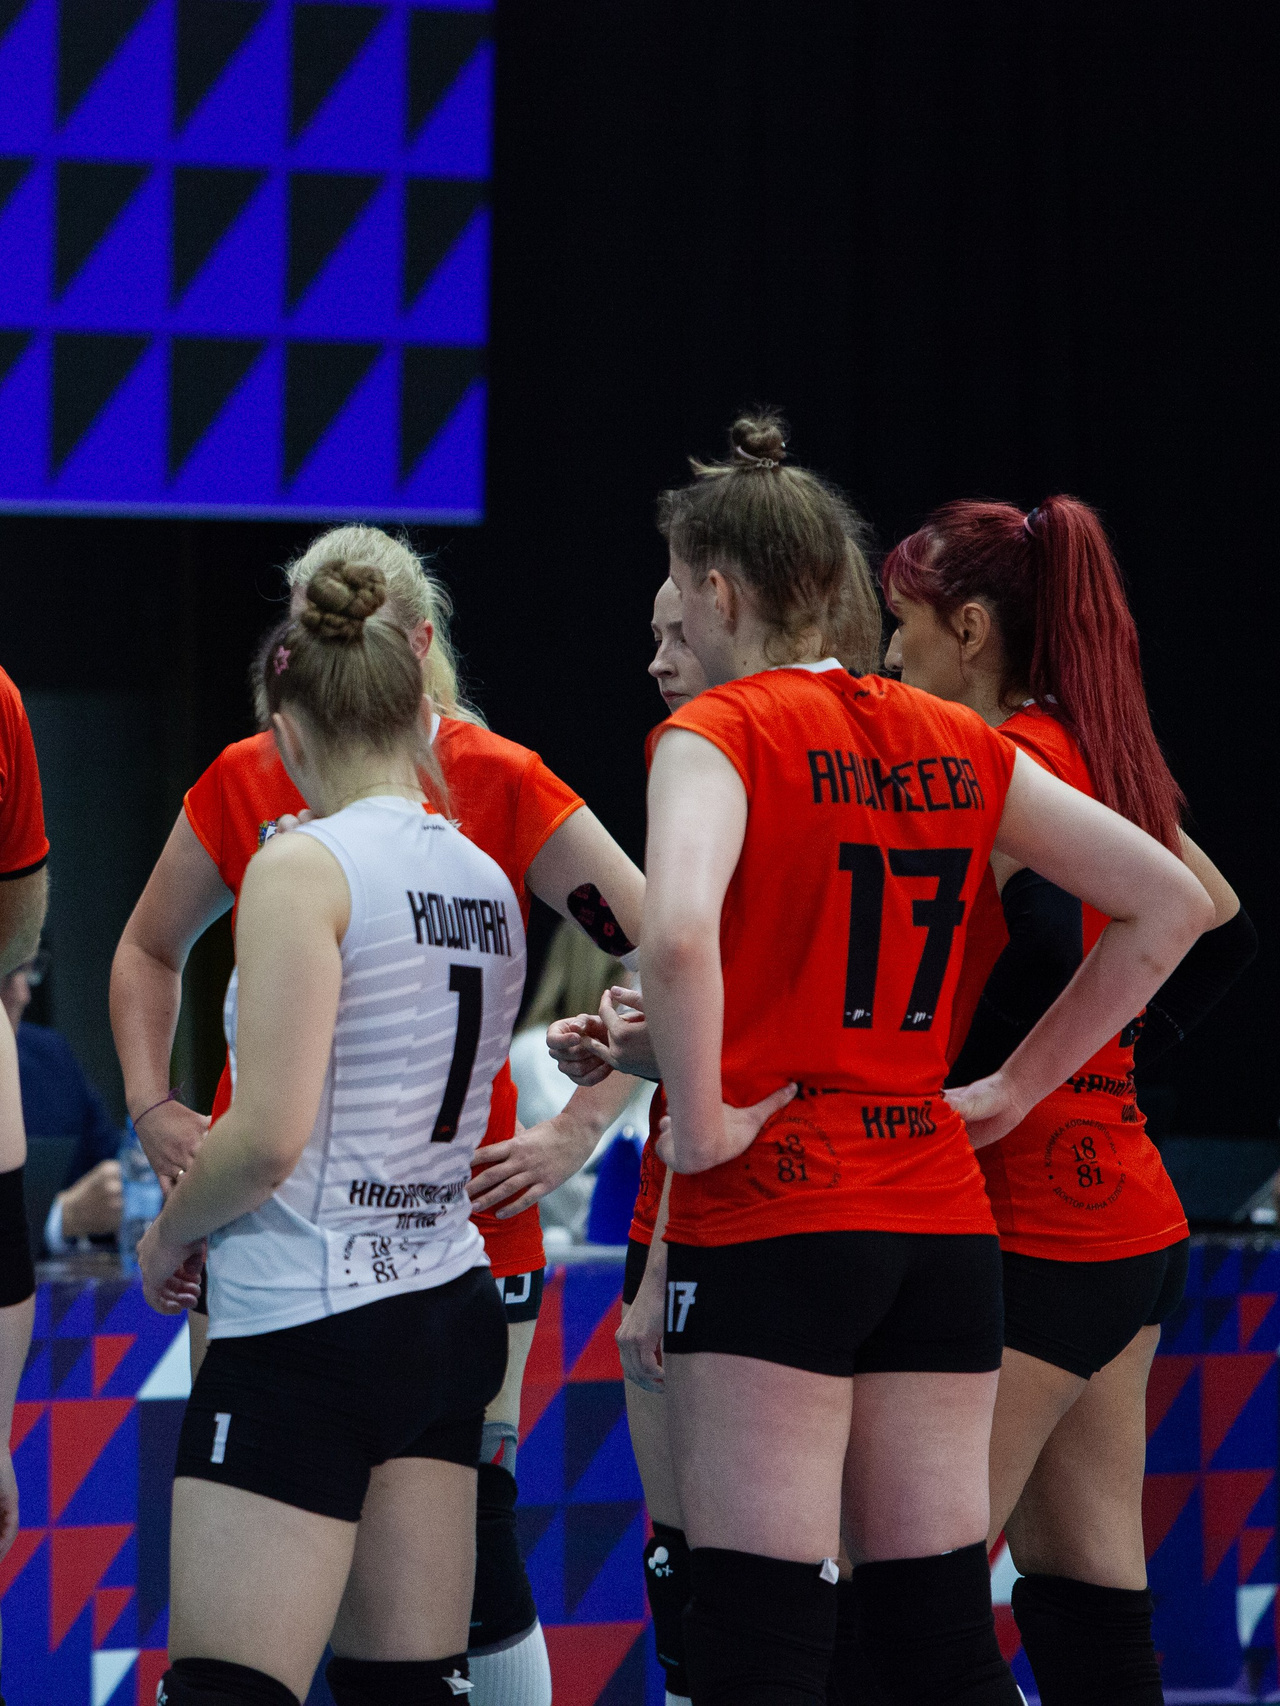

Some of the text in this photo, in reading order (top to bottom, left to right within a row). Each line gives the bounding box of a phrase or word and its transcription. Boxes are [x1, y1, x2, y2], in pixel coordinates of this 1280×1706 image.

[406, 889, 512, 957] КОШМАН
[838, 842, 974, 1032] 17
[431, 964, 484, 1144] 1
[861, 1100, 937, 1139] КРАЙ
[777, 1157, 809, 1183] 81
[1071, 1136, 1097, 1162] 18
[1076, 1164, 1105, 1188] 81
[372, 1260, 399, 1283] 81
[667, 1281, 699, 1332] 17
[210, 1412, 232, 1464] 1
